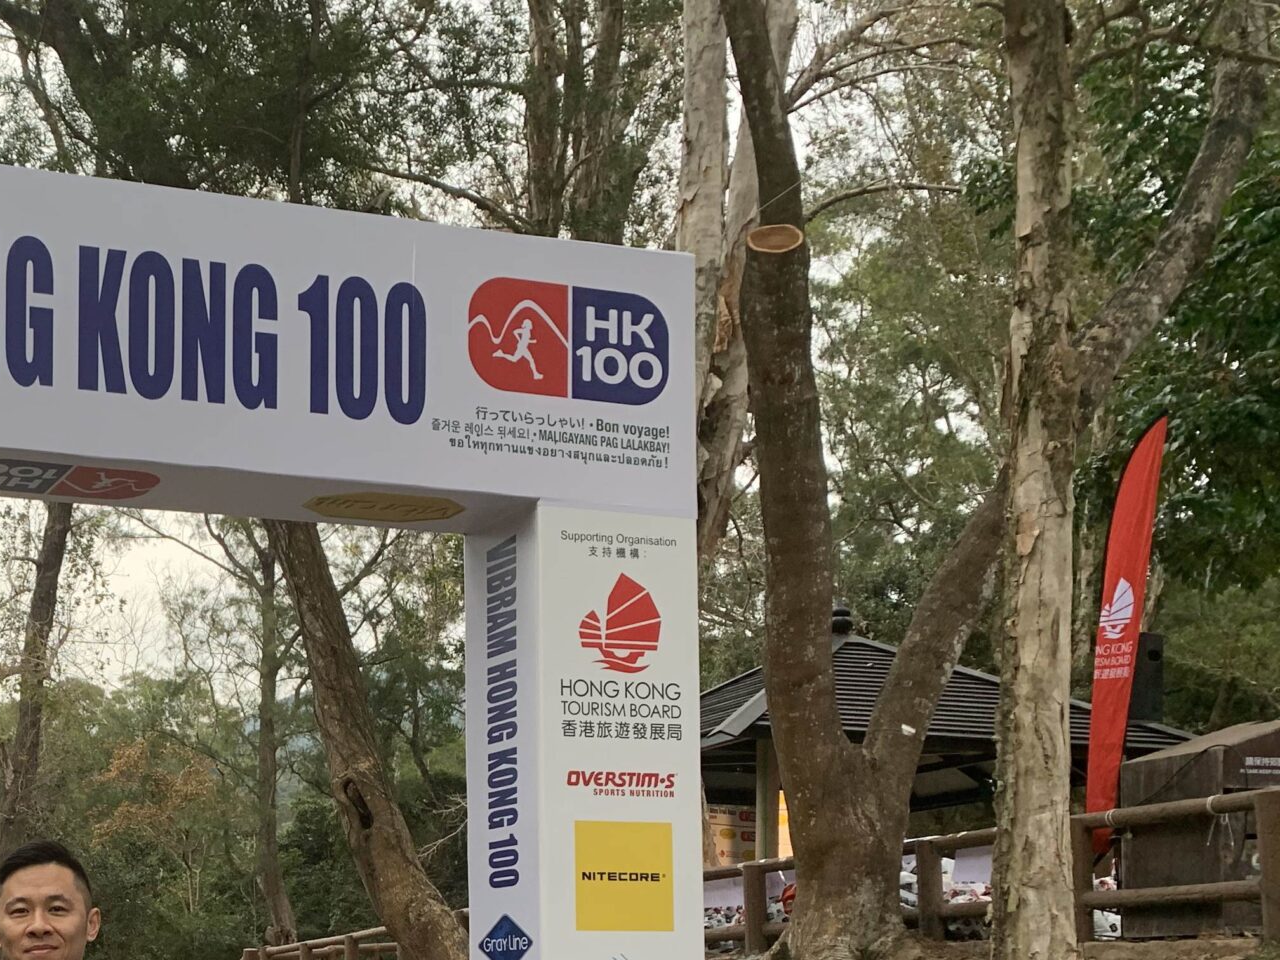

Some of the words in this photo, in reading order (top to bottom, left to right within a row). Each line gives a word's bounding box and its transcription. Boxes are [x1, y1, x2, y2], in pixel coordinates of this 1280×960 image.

[78, 245, 278, 410] KONG
[297, 274, 426, 425] 100
[586, 305, 655, 349] HK
[576, 346, 663, 389] 100
[539, 429, 598, 447] MALIGAYANG
[600, 435, 618, 449] PAG
[596, 419, 619, 433] Bon
[623, 424, 670, 440] voyage!
[561, 530, 613, 546] Supporting
[617, 533, 677, 548] Organisation
[486, 534, 518, 660] VIBRAM
[560, 678, 619, 698] HONG
[624, 681, 681, 701] KONG
[487, 667, 518, 745] HONG
[561, 700, 626, 718] TOURISM
[630, 703, 681, 719] BOARD
[561, 720, 682, 741] 香港旅遊發展局
[488, 746, 519, 830] KONG
[593, 787, 626, 797] SPORTS
[629, 788, 675, 798] NUTRITION
[488, 832, 521, 889] 100
[581, 871, 661, 882] NITECORE
